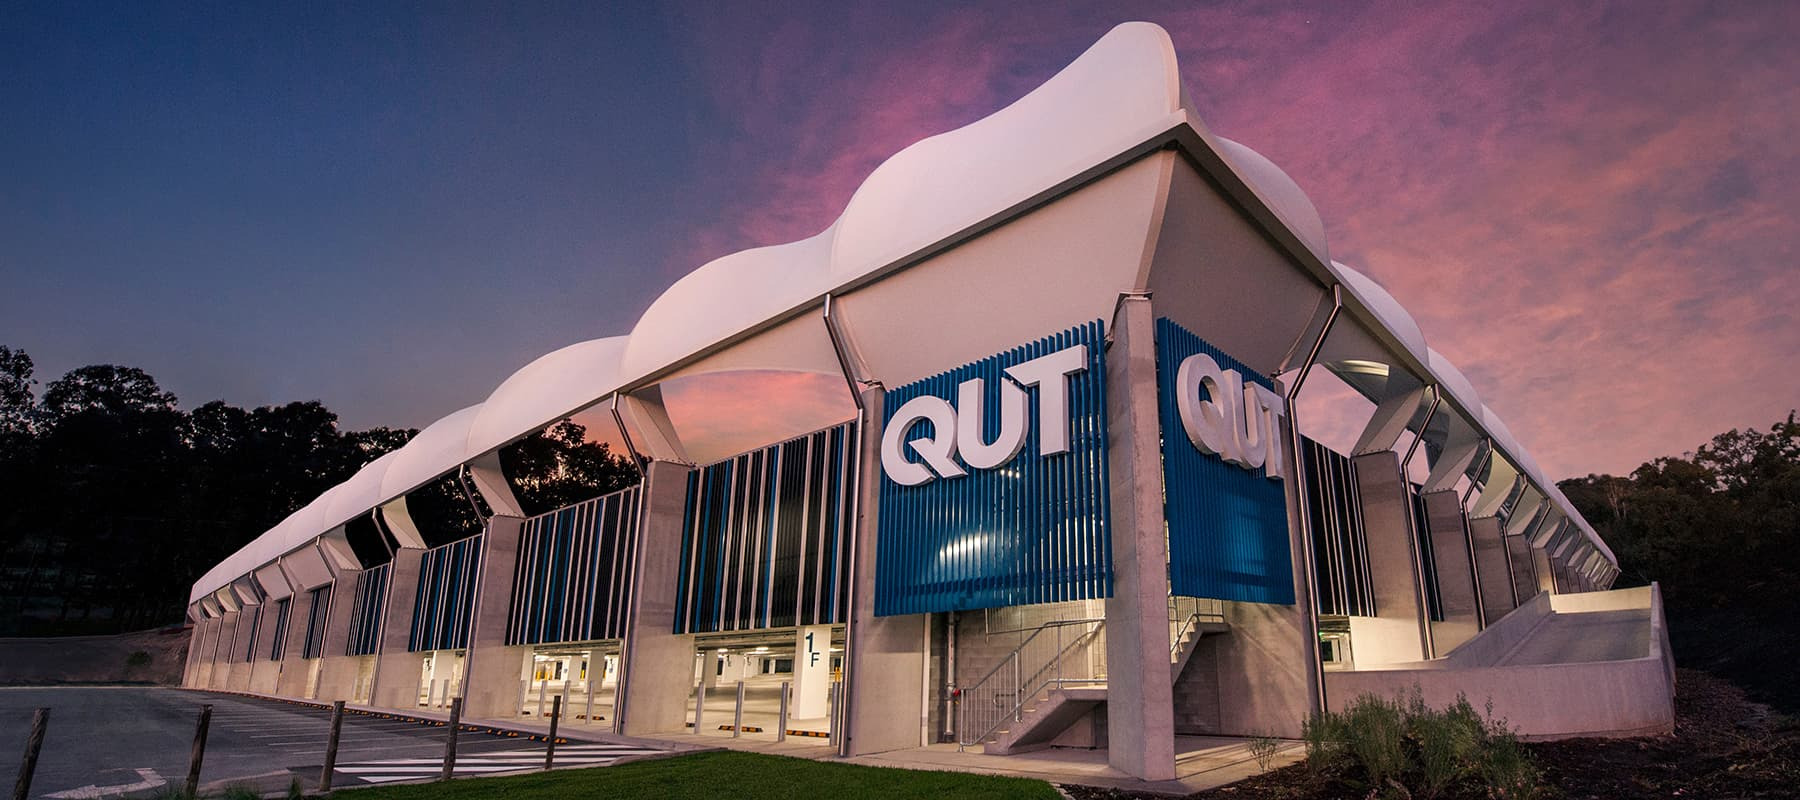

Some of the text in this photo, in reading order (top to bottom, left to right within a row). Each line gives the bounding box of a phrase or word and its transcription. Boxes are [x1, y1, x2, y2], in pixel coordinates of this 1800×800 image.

[881, 344, 1088, 486] QUT
[1176, 353, 1285, 480] QUT
[805, 632, 814, 653] 1
[810, 652, 820, 667] F
